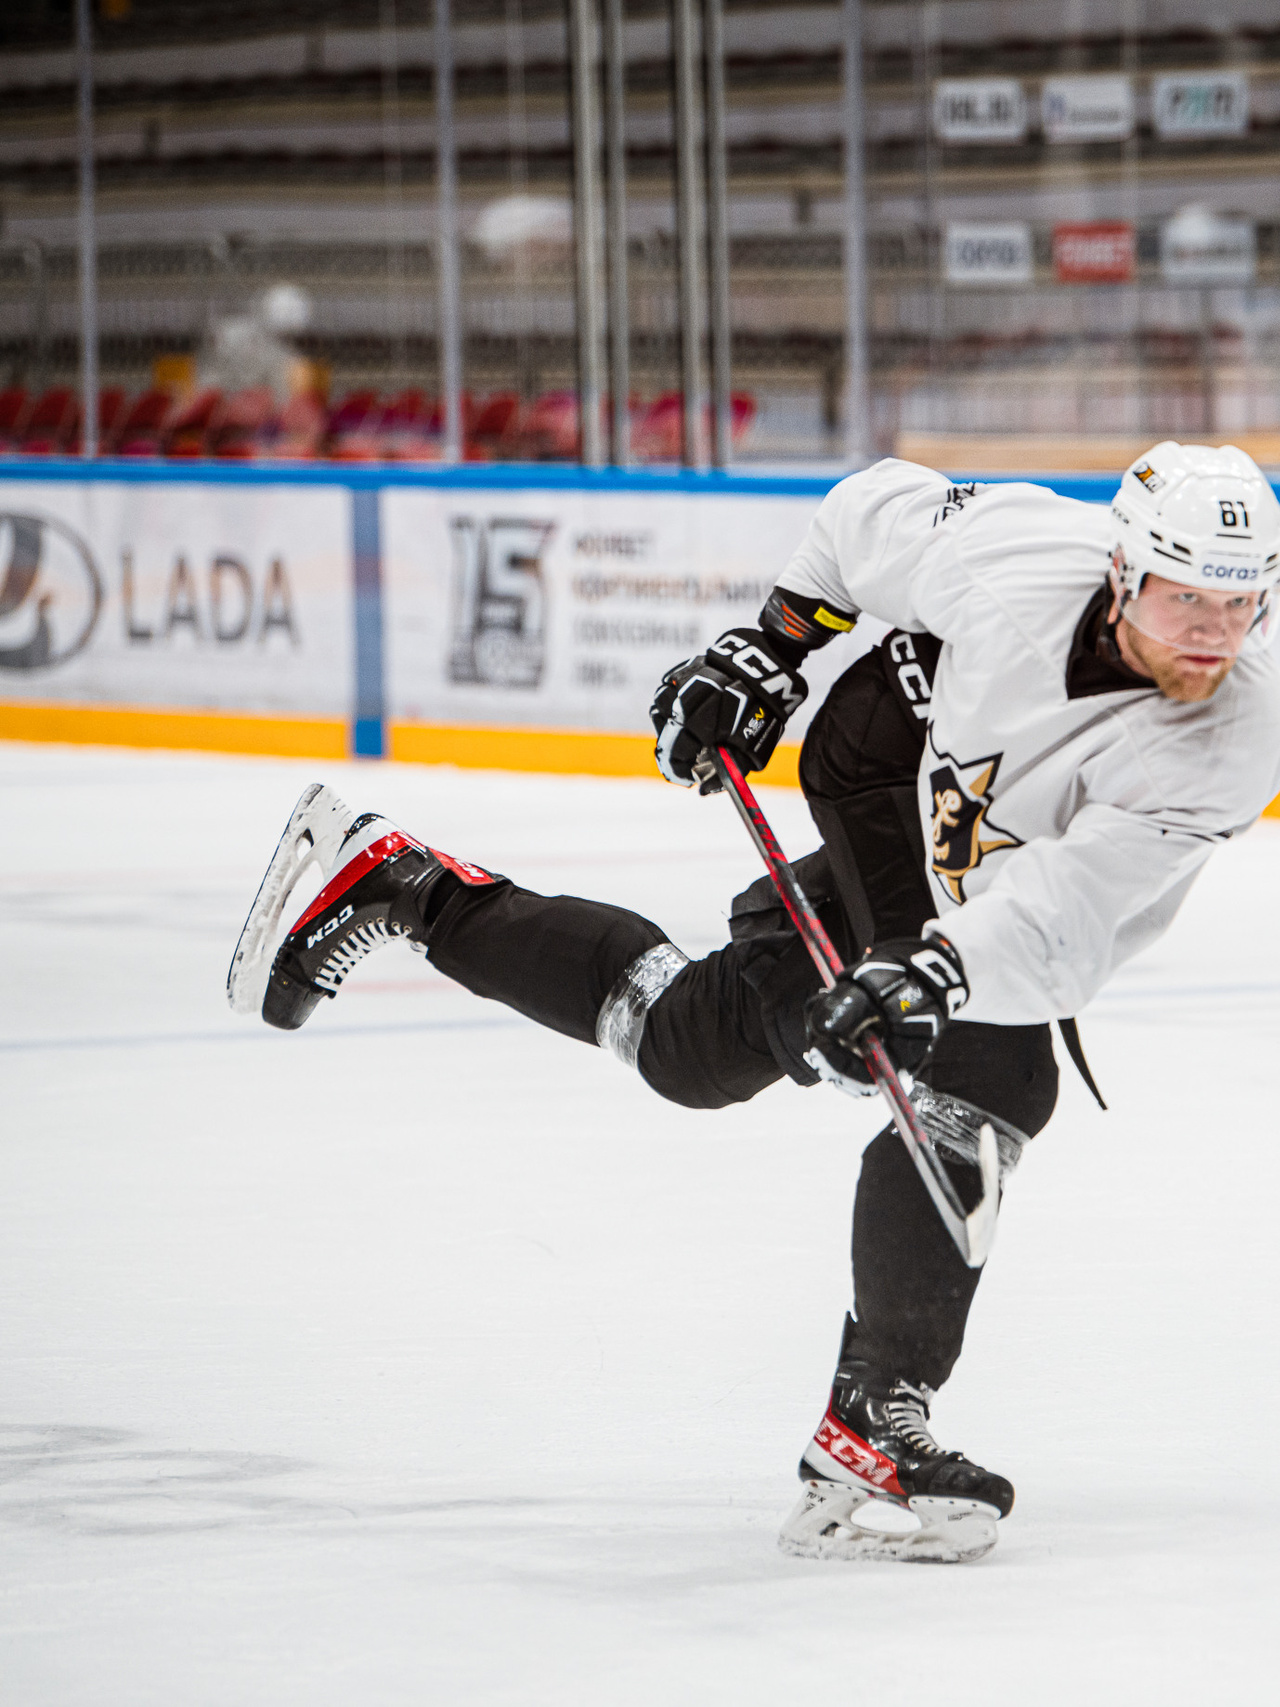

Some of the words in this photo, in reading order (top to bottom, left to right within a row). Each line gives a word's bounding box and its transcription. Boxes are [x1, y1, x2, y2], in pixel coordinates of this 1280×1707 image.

[120, 548, 303, 651] LADA
[711, 634, 804, 713] CCM
[306, 904, 356, 949] CCM
[814, 1418, 893, 1486] CCM
